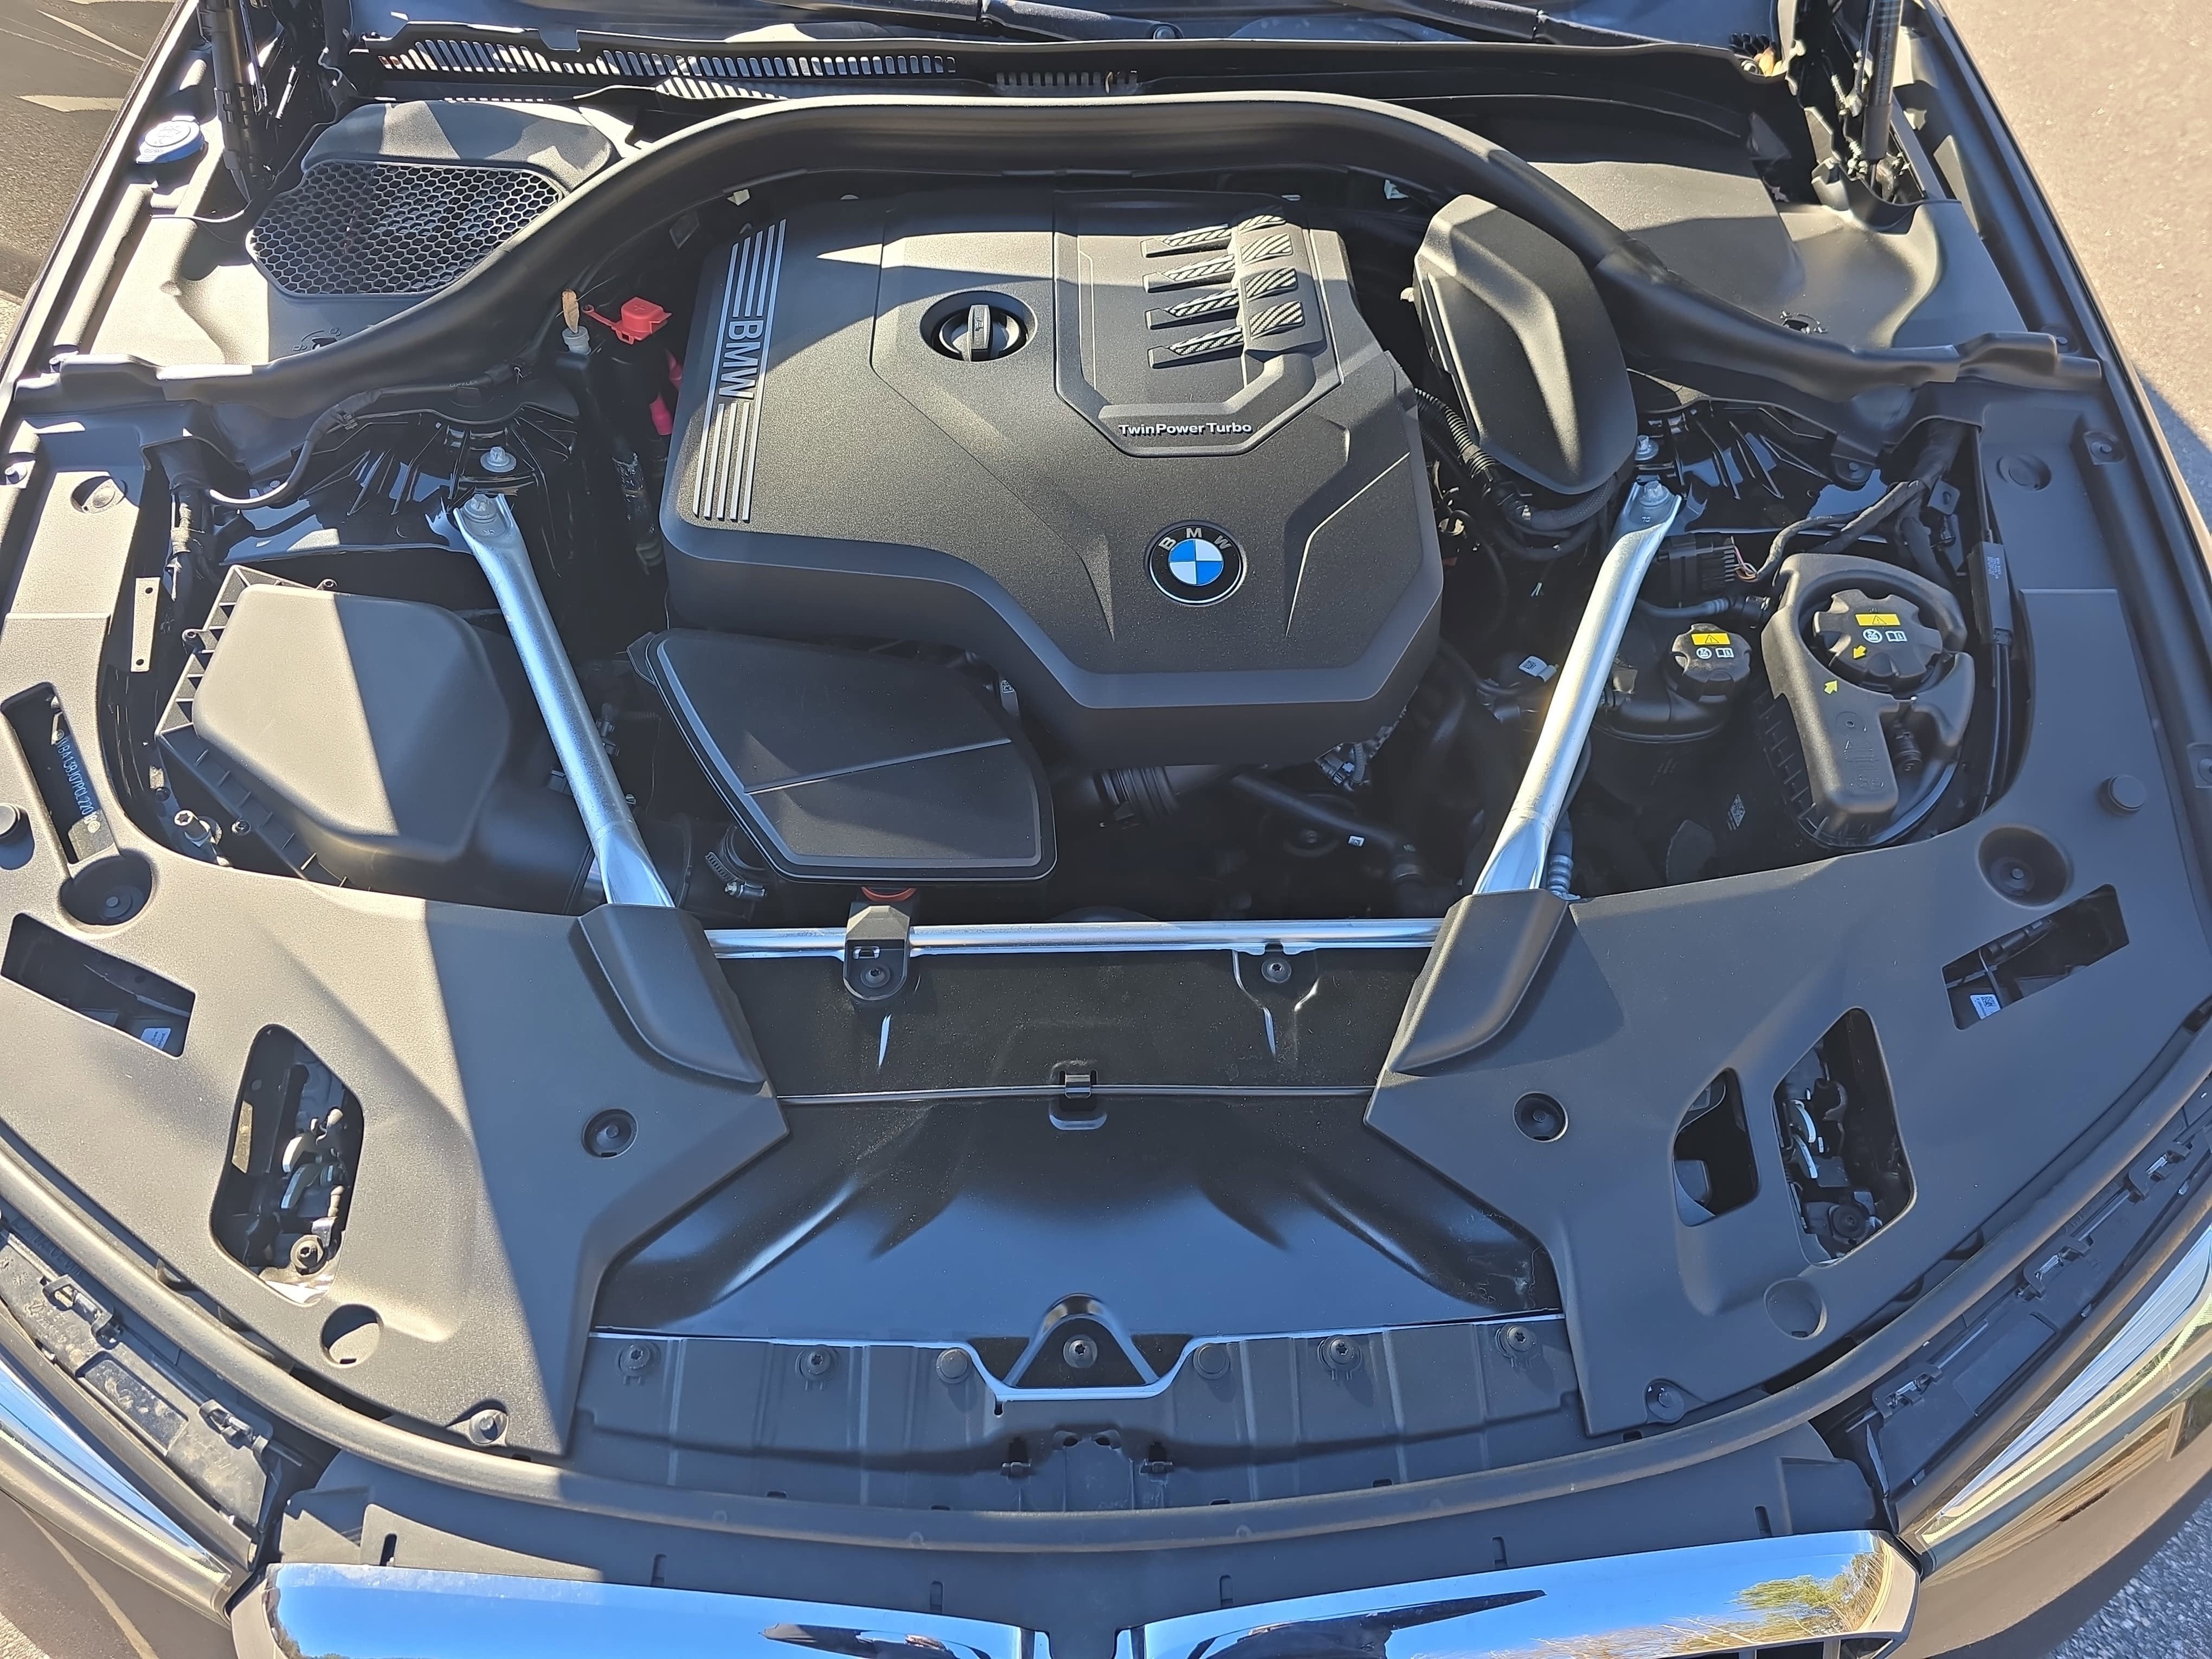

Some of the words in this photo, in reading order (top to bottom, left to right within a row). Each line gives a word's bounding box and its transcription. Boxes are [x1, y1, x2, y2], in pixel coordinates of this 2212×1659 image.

[719, 320, 763, 399] BMW
[1207, 422, 1252, 433] Turbo
[1159, 528, 1232, 551] BMW
